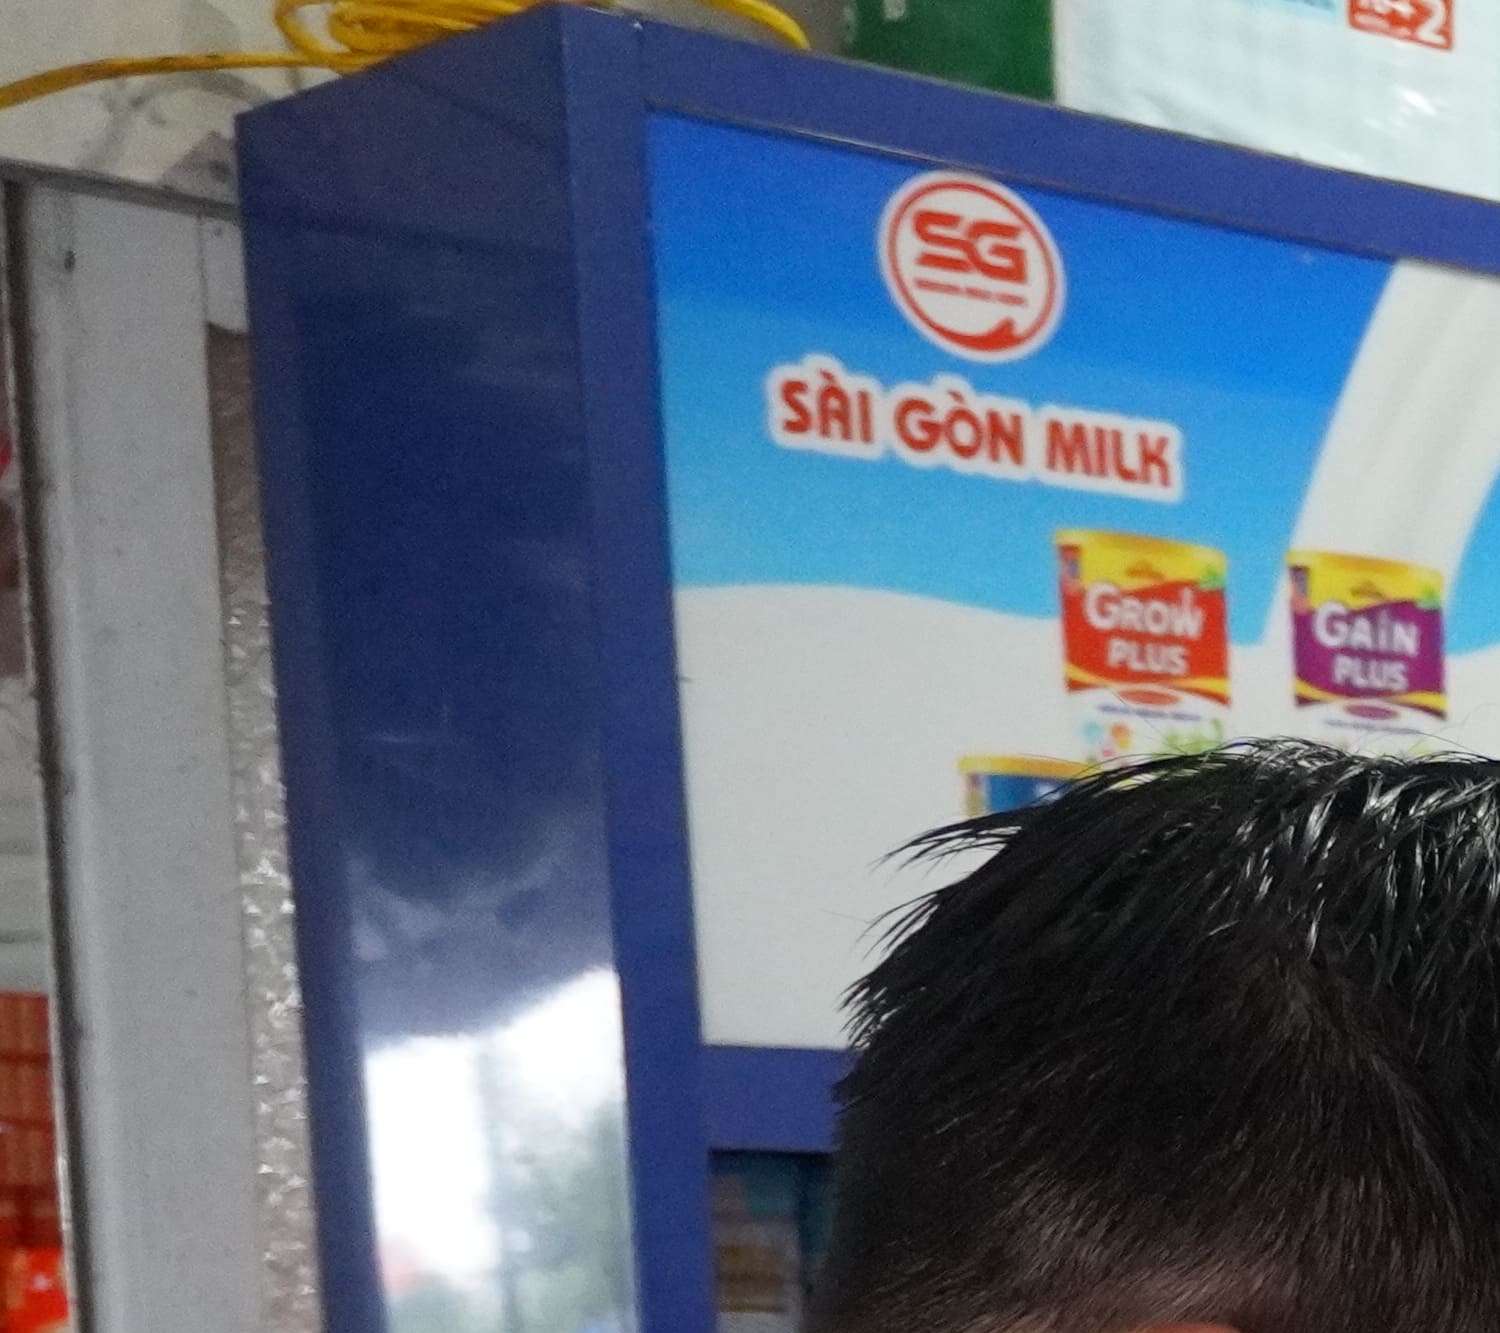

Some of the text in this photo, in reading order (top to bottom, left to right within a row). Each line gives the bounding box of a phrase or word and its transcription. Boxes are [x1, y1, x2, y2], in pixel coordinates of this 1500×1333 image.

[912, 209, 1028, 286] SG
[779, 369, 1172, 490] SÀI GÒN MILK
[1083, 587, 1207, 640] GROW
[1106, 637, 1190, 678] PLUS
[1331, 653, 1409, 692] PLUS
